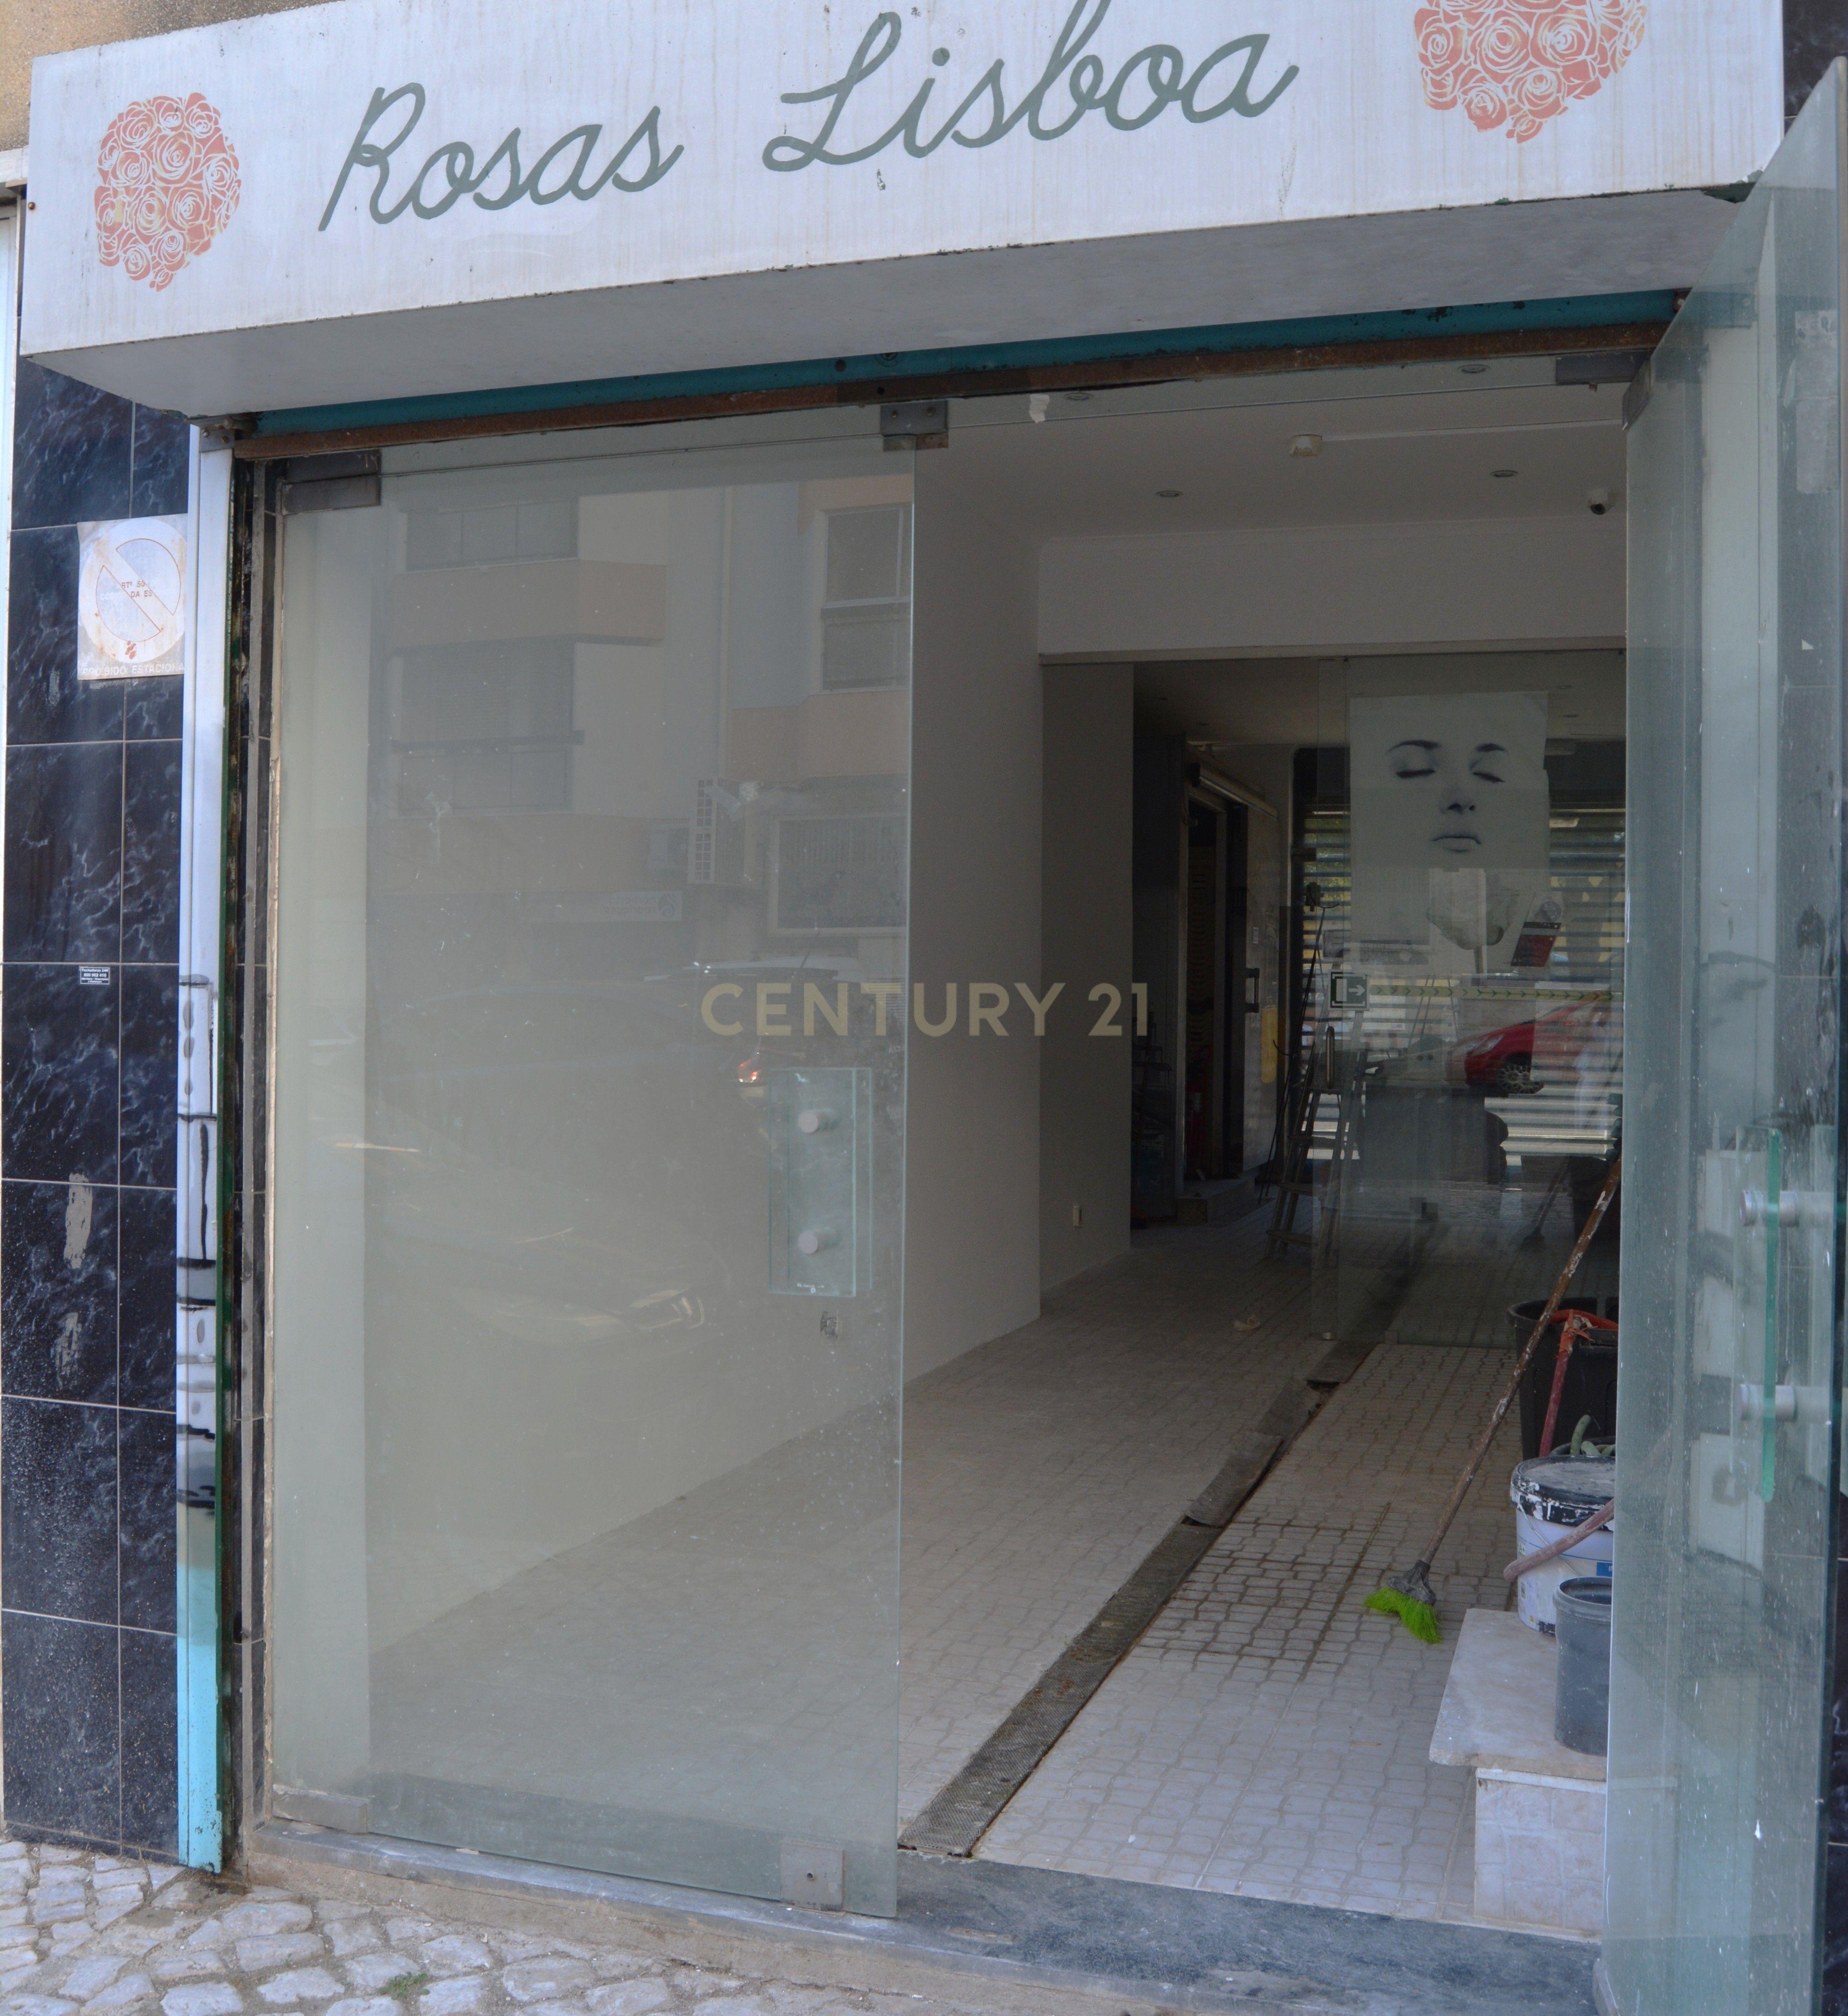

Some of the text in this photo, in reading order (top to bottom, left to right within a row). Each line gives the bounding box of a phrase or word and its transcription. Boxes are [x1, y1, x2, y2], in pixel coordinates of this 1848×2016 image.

[318, 0, 1299, 231] Rosas Lisboa
[82, 665, 126, 676] PROIBIDO
